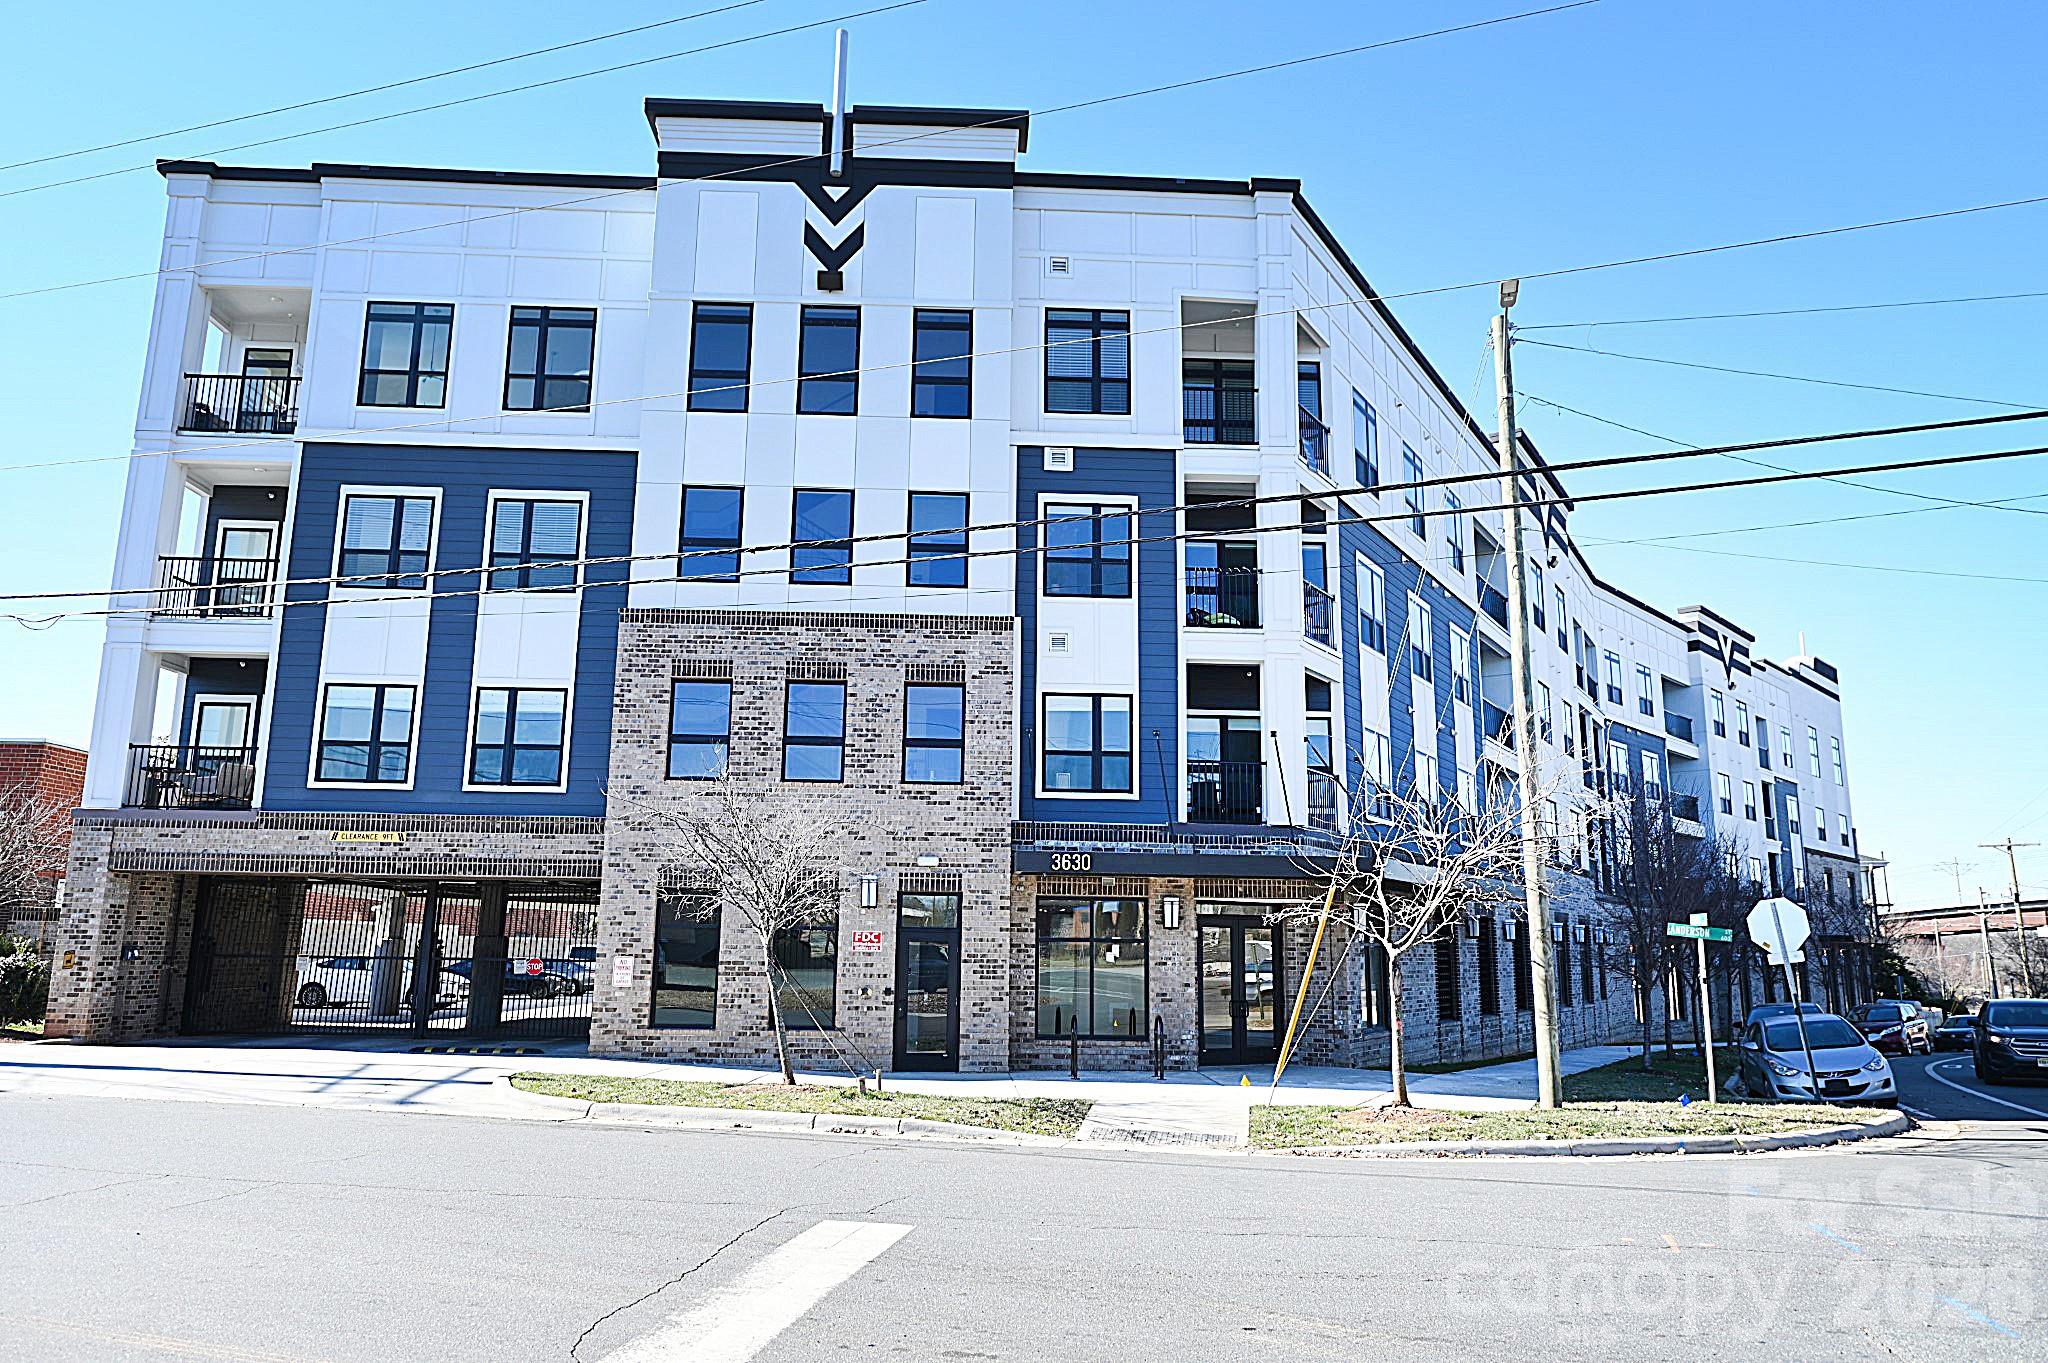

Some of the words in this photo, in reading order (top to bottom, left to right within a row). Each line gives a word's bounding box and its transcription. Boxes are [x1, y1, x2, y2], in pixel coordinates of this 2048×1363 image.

[1052, 854, 1091, 870] 3630
[854, 932, 879, 942] FDC
[1670, 925, 1710, 938] ANDERSON
